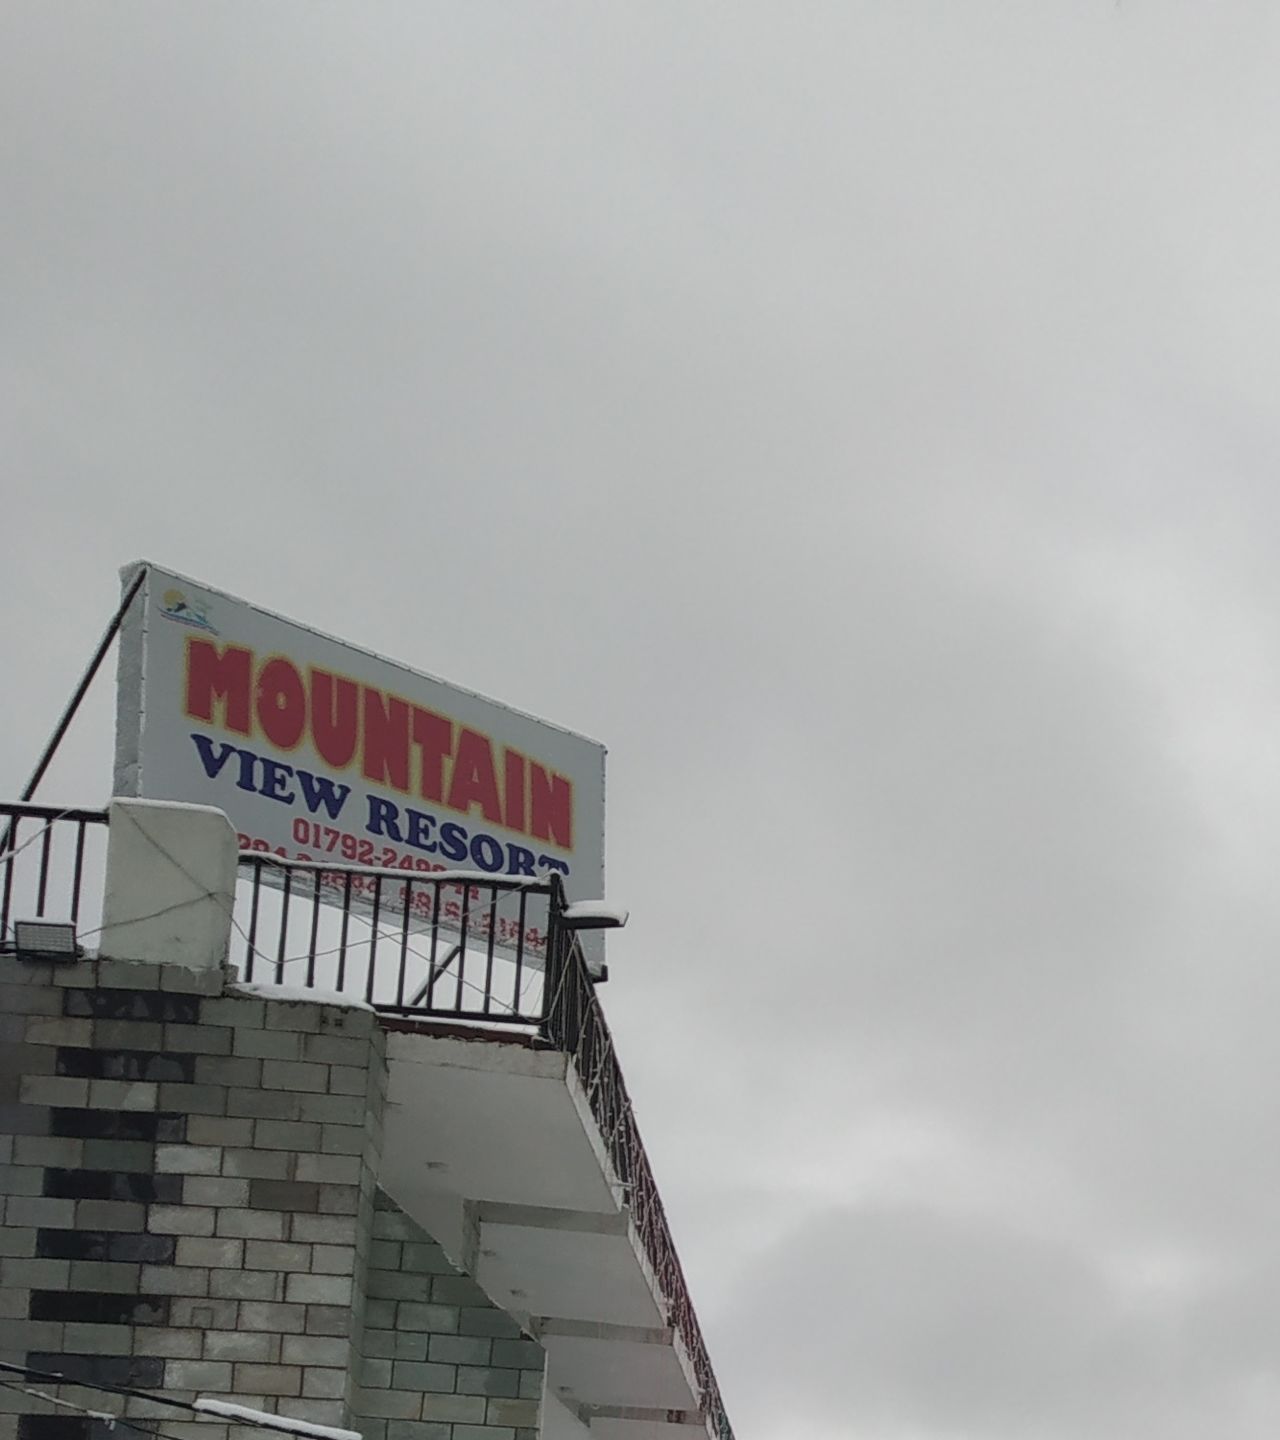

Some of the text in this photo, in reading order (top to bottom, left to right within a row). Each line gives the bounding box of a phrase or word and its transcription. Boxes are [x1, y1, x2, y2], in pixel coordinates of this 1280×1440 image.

[184, 634, 573, 853] MOUNTAIN
[191, 733, 351, 820] VIEW
[366, 795, 570, 878] RESORT
